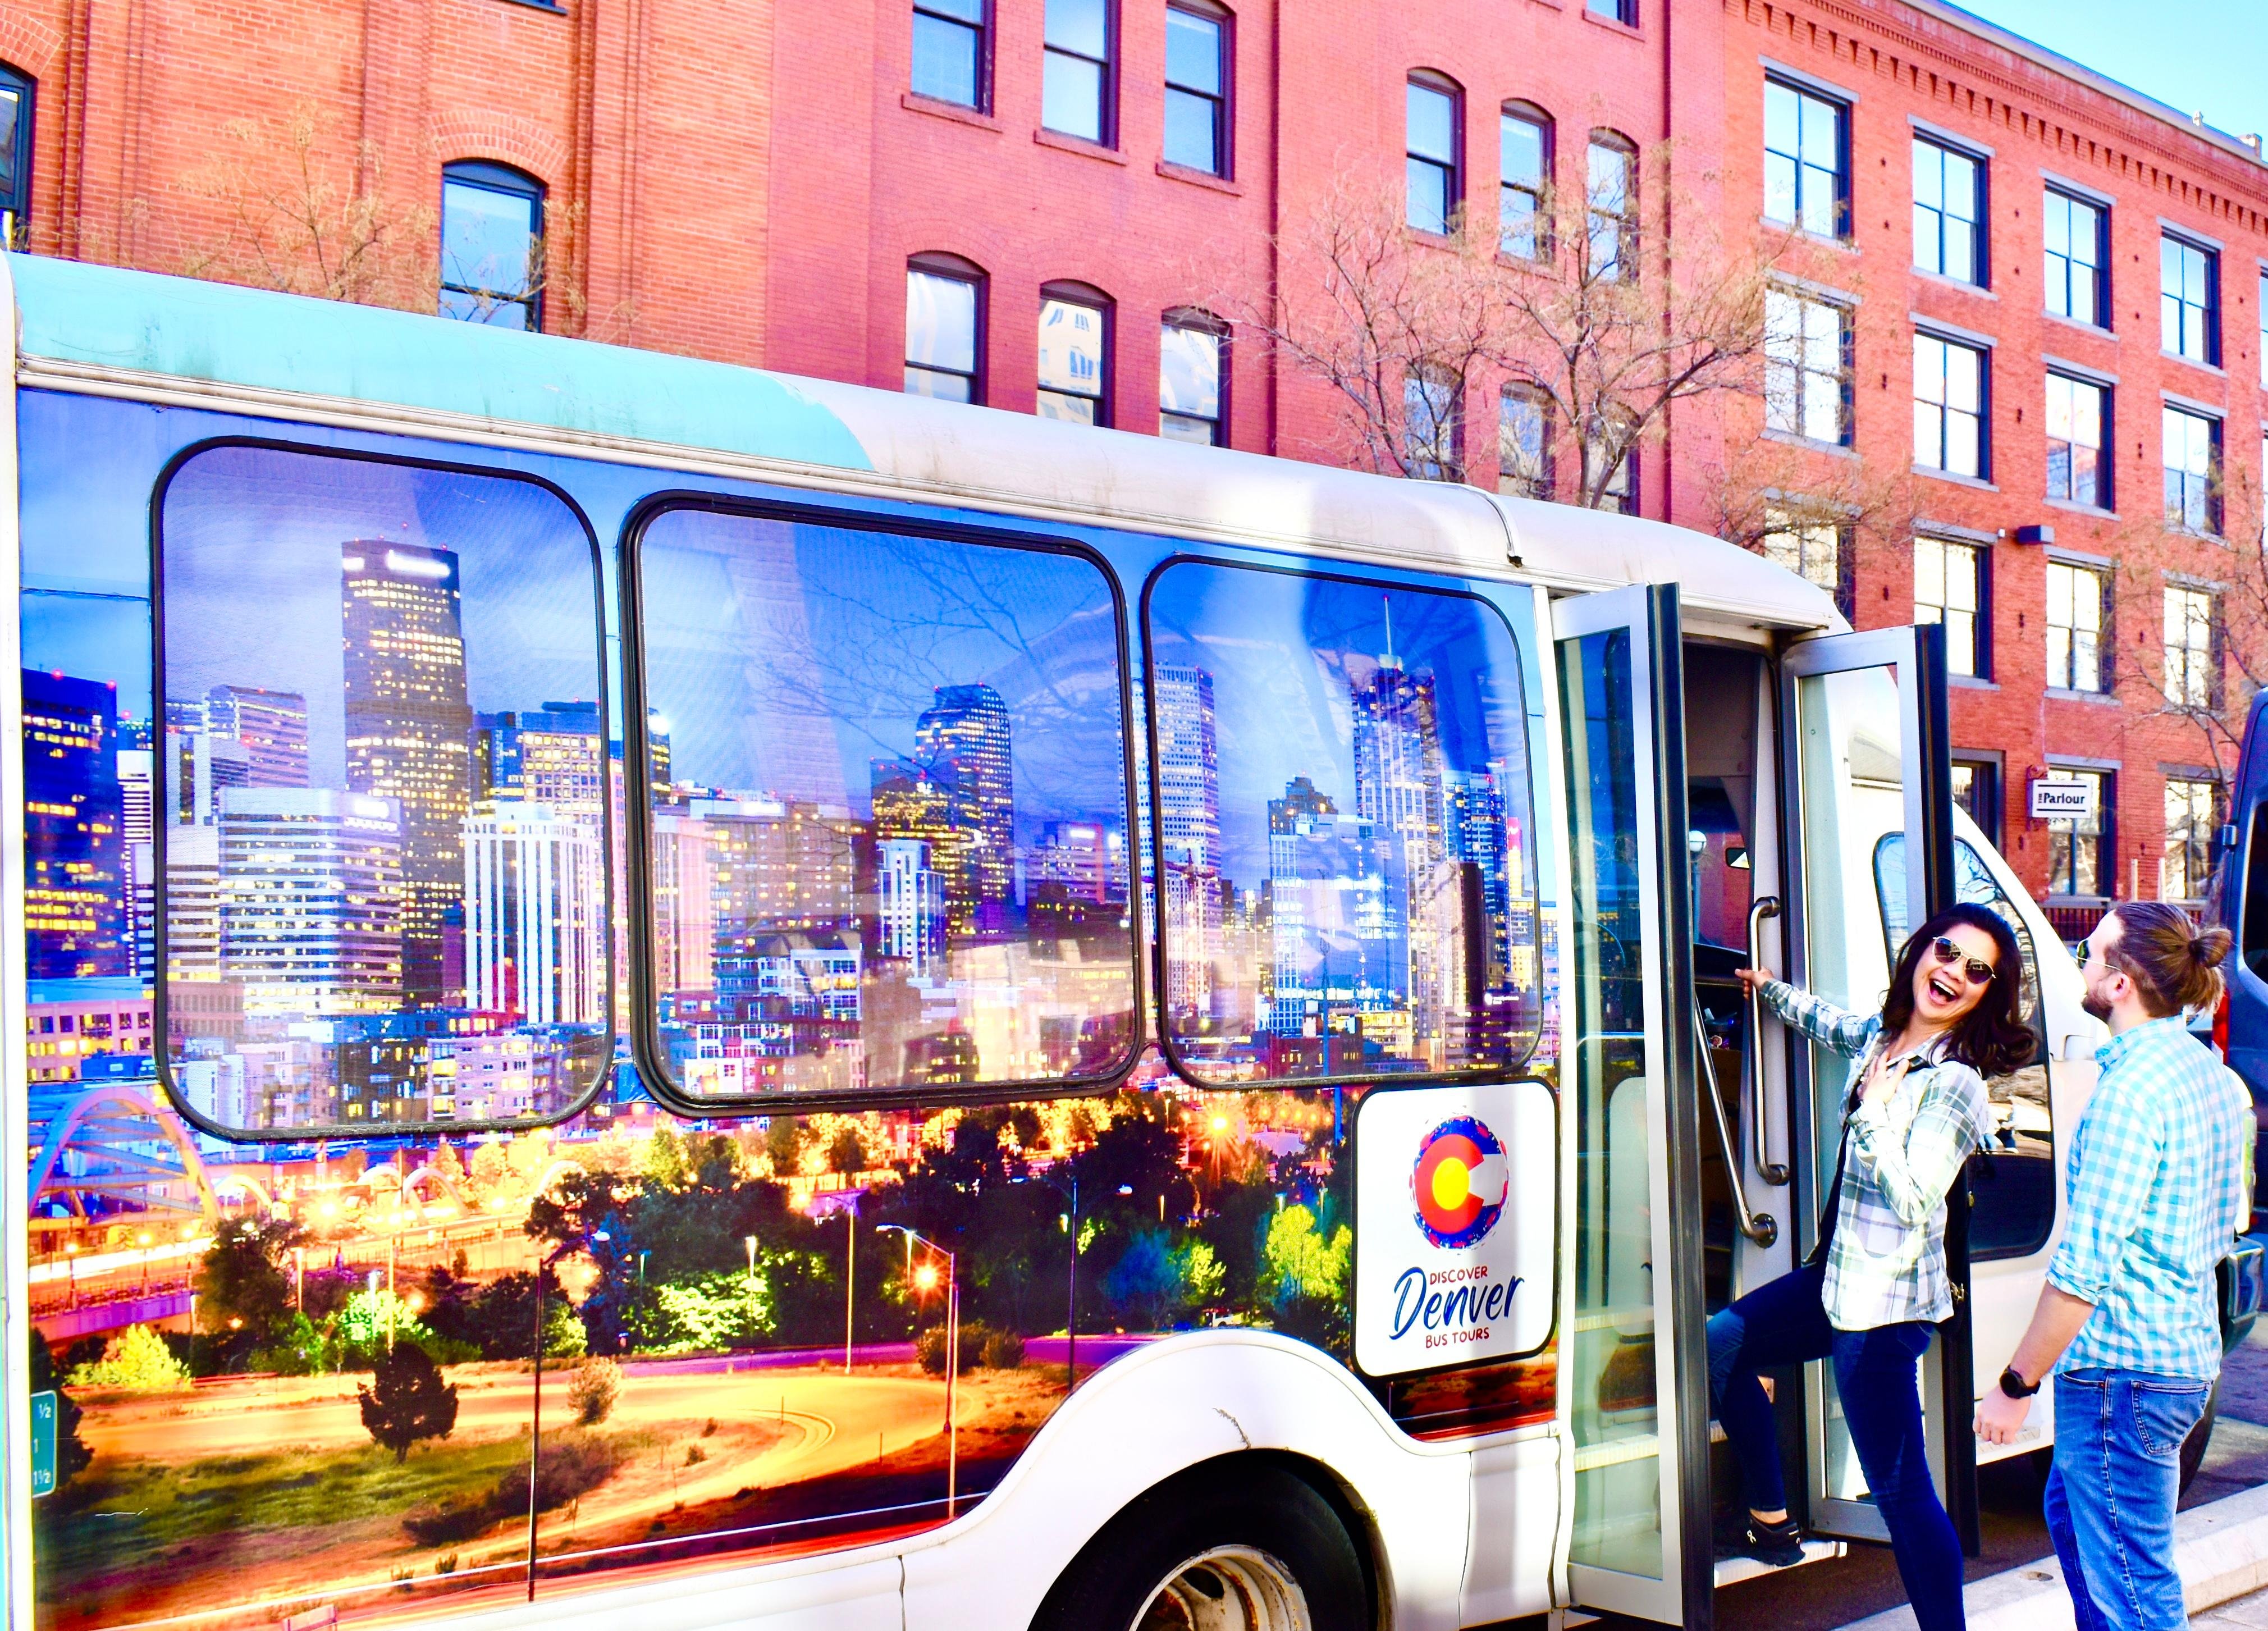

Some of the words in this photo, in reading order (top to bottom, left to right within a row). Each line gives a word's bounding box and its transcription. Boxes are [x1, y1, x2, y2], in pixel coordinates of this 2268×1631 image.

[2043, 792, 2086, 804] Parlour
[1429, 1265, 1488, 1285] DISCOVER
[1388, 1266, 1525, 1340] Denver
[1425, 1333, 1448, 1349] BUS
[1452, 1327, 1489, 1344] TOURS
